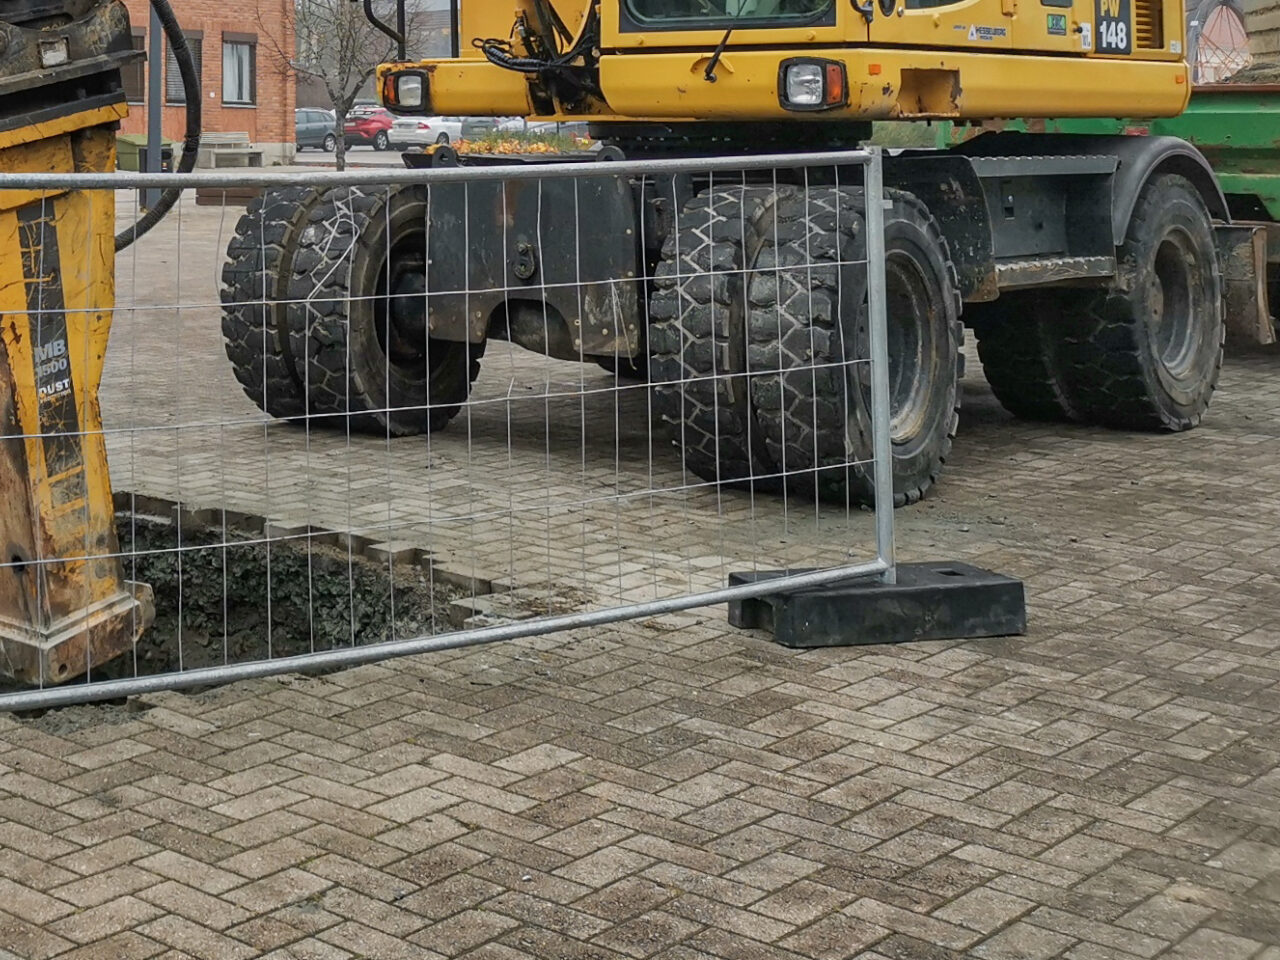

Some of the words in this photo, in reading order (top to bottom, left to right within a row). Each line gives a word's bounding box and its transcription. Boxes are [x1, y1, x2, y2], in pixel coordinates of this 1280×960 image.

[1099, 20, 1127, 49] 148
[33, 339, 66, 362] MB
[35, 358, 68, 378] 1500
